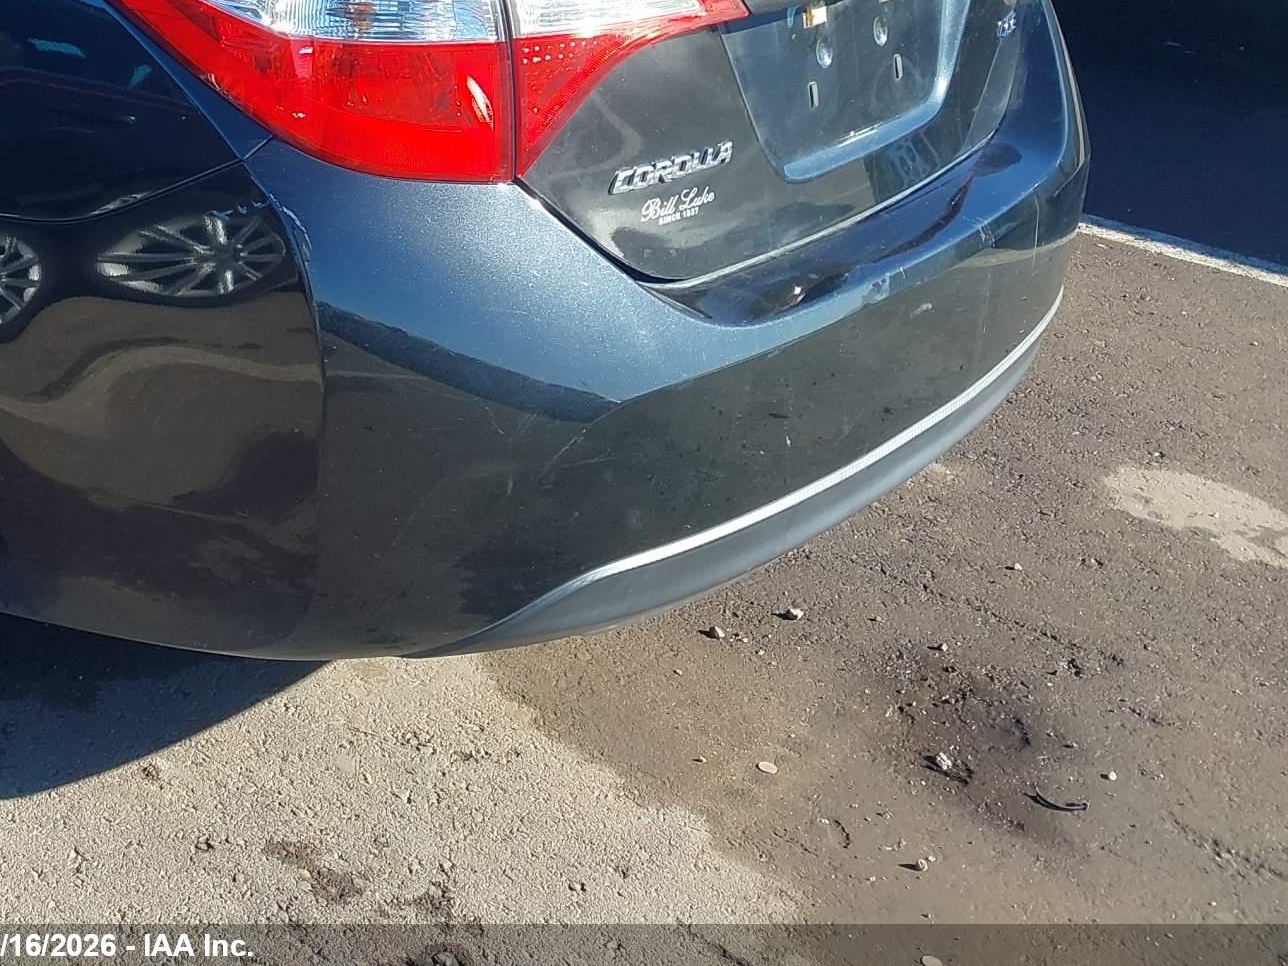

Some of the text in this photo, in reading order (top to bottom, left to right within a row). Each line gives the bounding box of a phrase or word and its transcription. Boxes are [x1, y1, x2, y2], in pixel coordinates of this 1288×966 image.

[608, 139, 733, 195] COROLLA
[640, 186, 715, 222] Bill Luke
